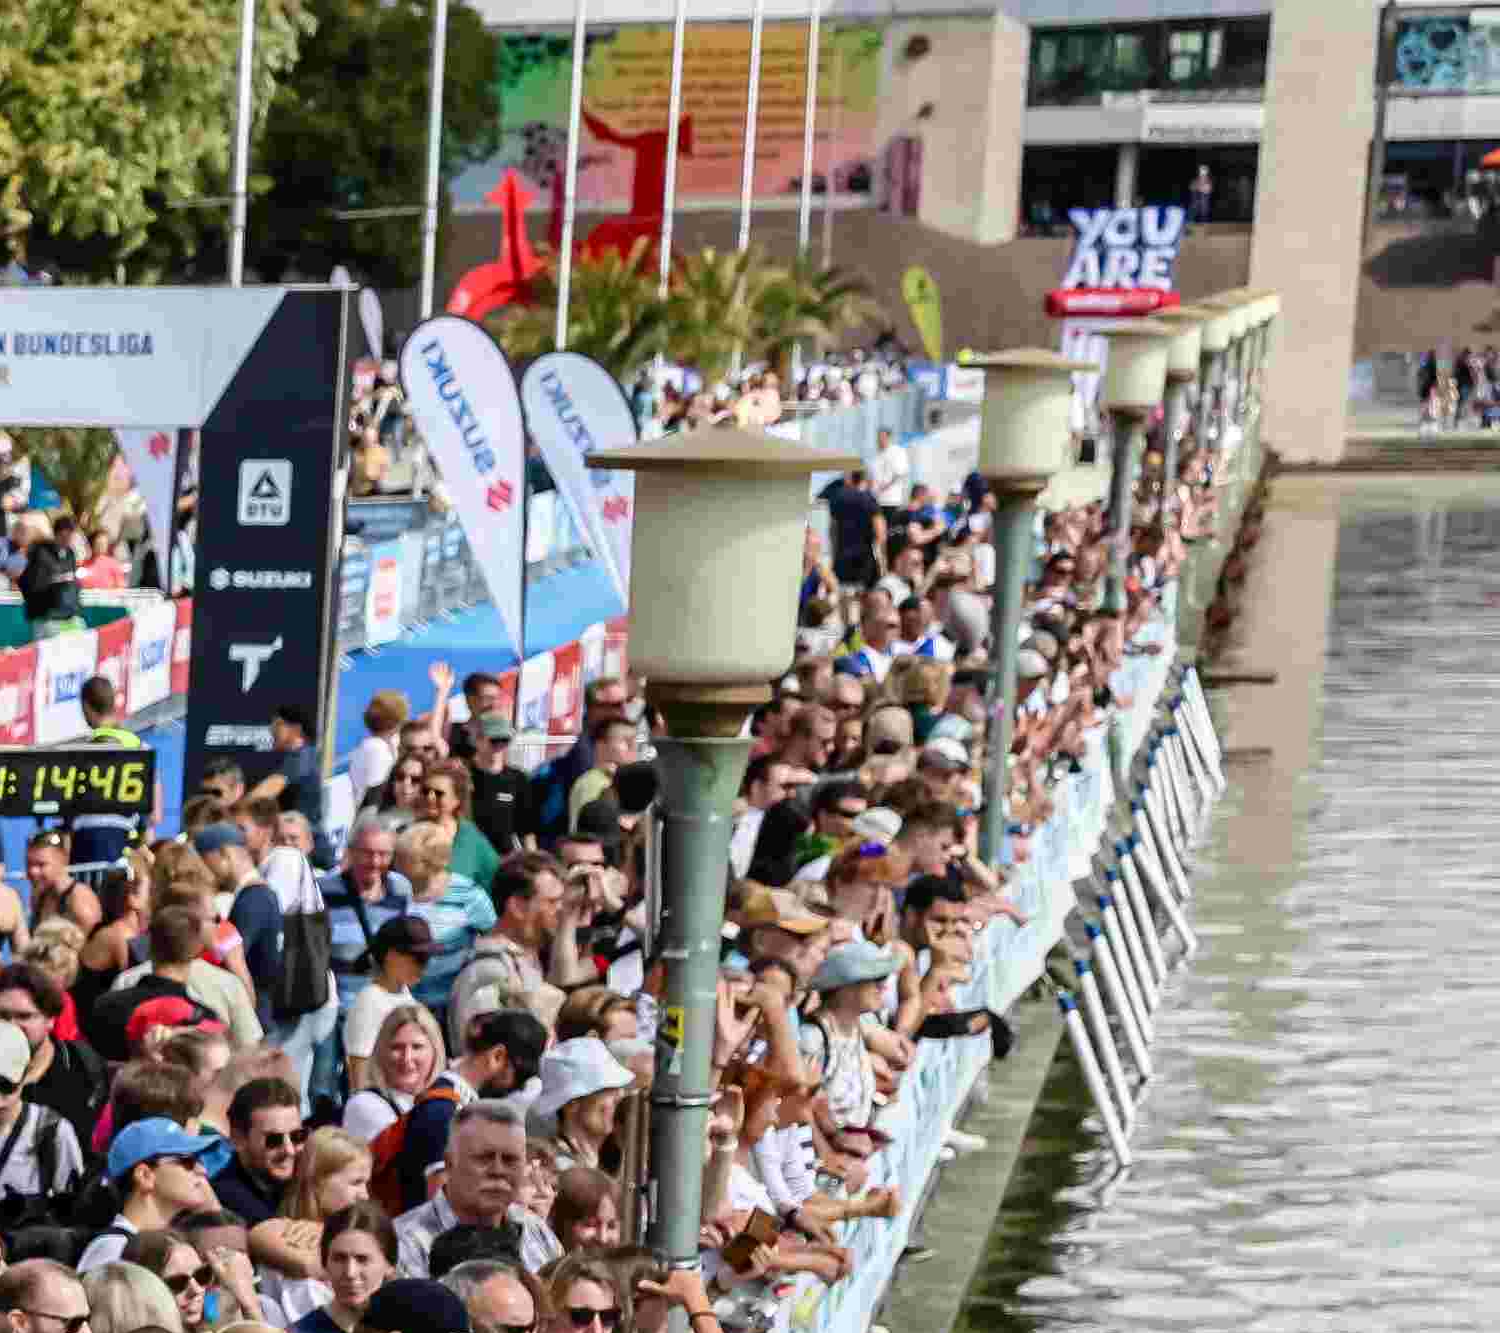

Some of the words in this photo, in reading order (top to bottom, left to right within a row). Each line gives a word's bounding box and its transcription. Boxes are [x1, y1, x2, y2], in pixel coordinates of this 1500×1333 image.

[1069, 206, 1186, 248] YOU
[1061, 247, 1180, 290] ARE
[12, 332, 155, 357] BUNDESLIGA
